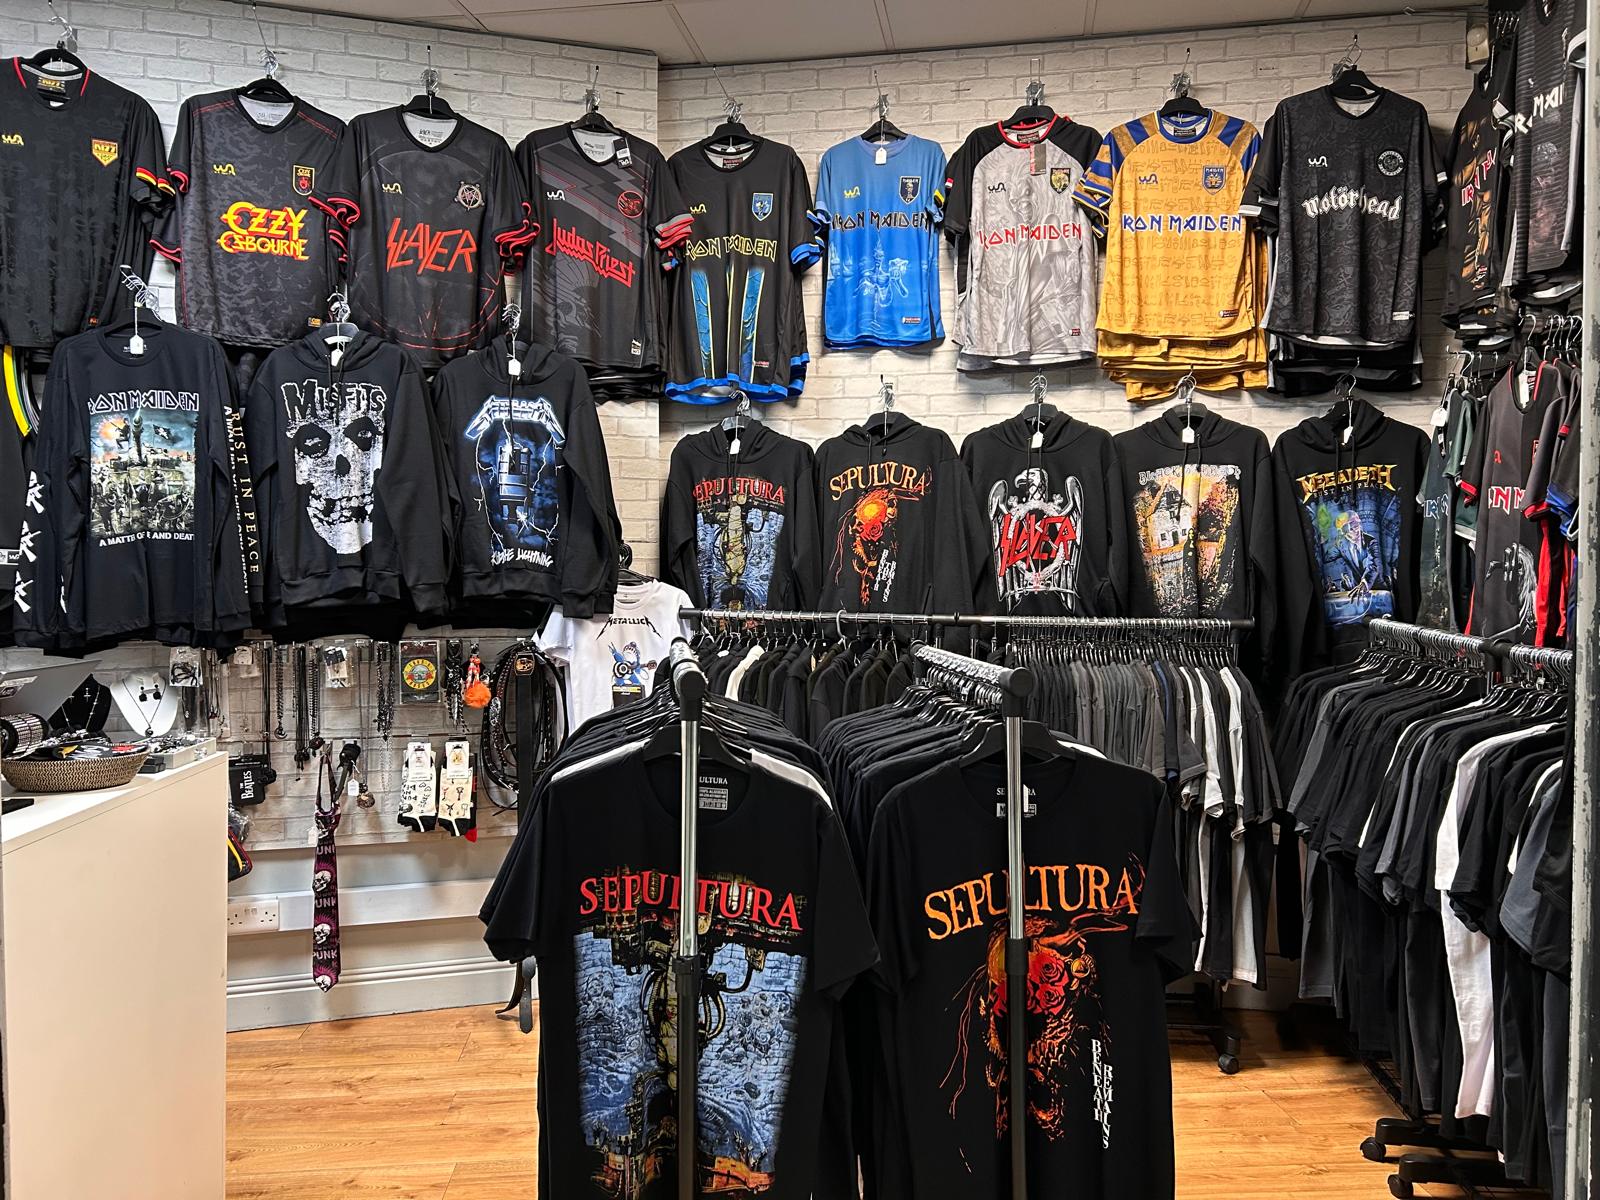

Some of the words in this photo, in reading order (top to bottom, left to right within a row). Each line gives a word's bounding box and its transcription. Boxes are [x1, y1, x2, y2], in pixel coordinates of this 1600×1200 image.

[220, 201, 308, 240] OZZY
[868, 208, 929, 233] MAIDEN
[1018, 222, 1083, 242] MAIDEN
[1121, 213, 1163, 235] RON
[1168, 213, 1242, 237] MAIDEN
[216, 231, 310, 261] OSBOURNE
[386, 217, 477, 275] SLAYER
[685, 236, 721, 261] RON
[723, 234, 778, 262] MAIDEN
[88, 392, 128, 415] RON
[128, 389, 200, 413] MAIDEN
[231, 412, 249, 465] RUST
[240, 477, 253, 498] IN
[693, 477, 786, 505] EPULTURA
[829, 461, 926, 501] SEPULTURA
[1295, 464, 1398, 505] MEGADETH
[152, 532, 172, 540] AND
[173, 532, 195, 541] DEAT
[244, 511, 260, 573] PEACE
[999, 512, 1077, 577] SLAYER
[240, 770, 255, 800] BEATLES
[699, 776, 728, 785] ULTURA
[924, 864, 1139, 941] SEPUTURA
[1091, 1038, 1103, 1124] BENEATH
